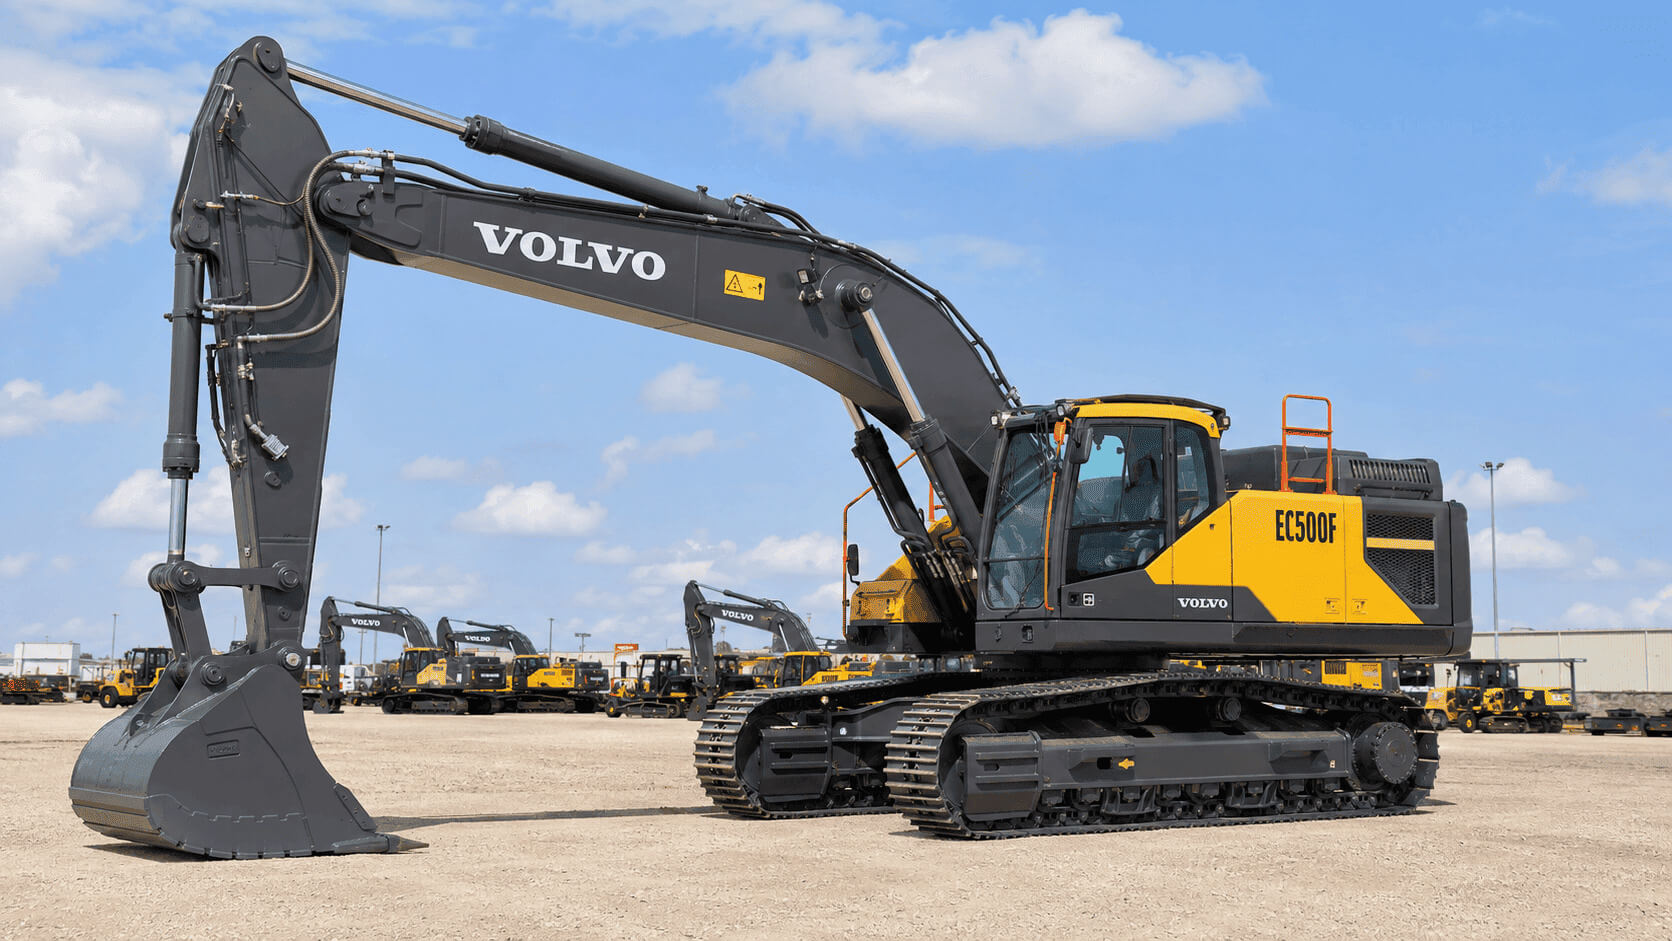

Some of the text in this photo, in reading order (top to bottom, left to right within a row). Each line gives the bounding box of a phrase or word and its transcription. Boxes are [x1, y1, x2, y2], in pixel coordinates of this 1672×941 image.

[473, 222, 666, 281] VOLVO
[1275, 509, 1337, 544] EC500F
[1177, 597, 1228, 609] VOLVO
[721, 609, 754, 622] VOLVO
[351, 618, 381, 627] VOLVO
